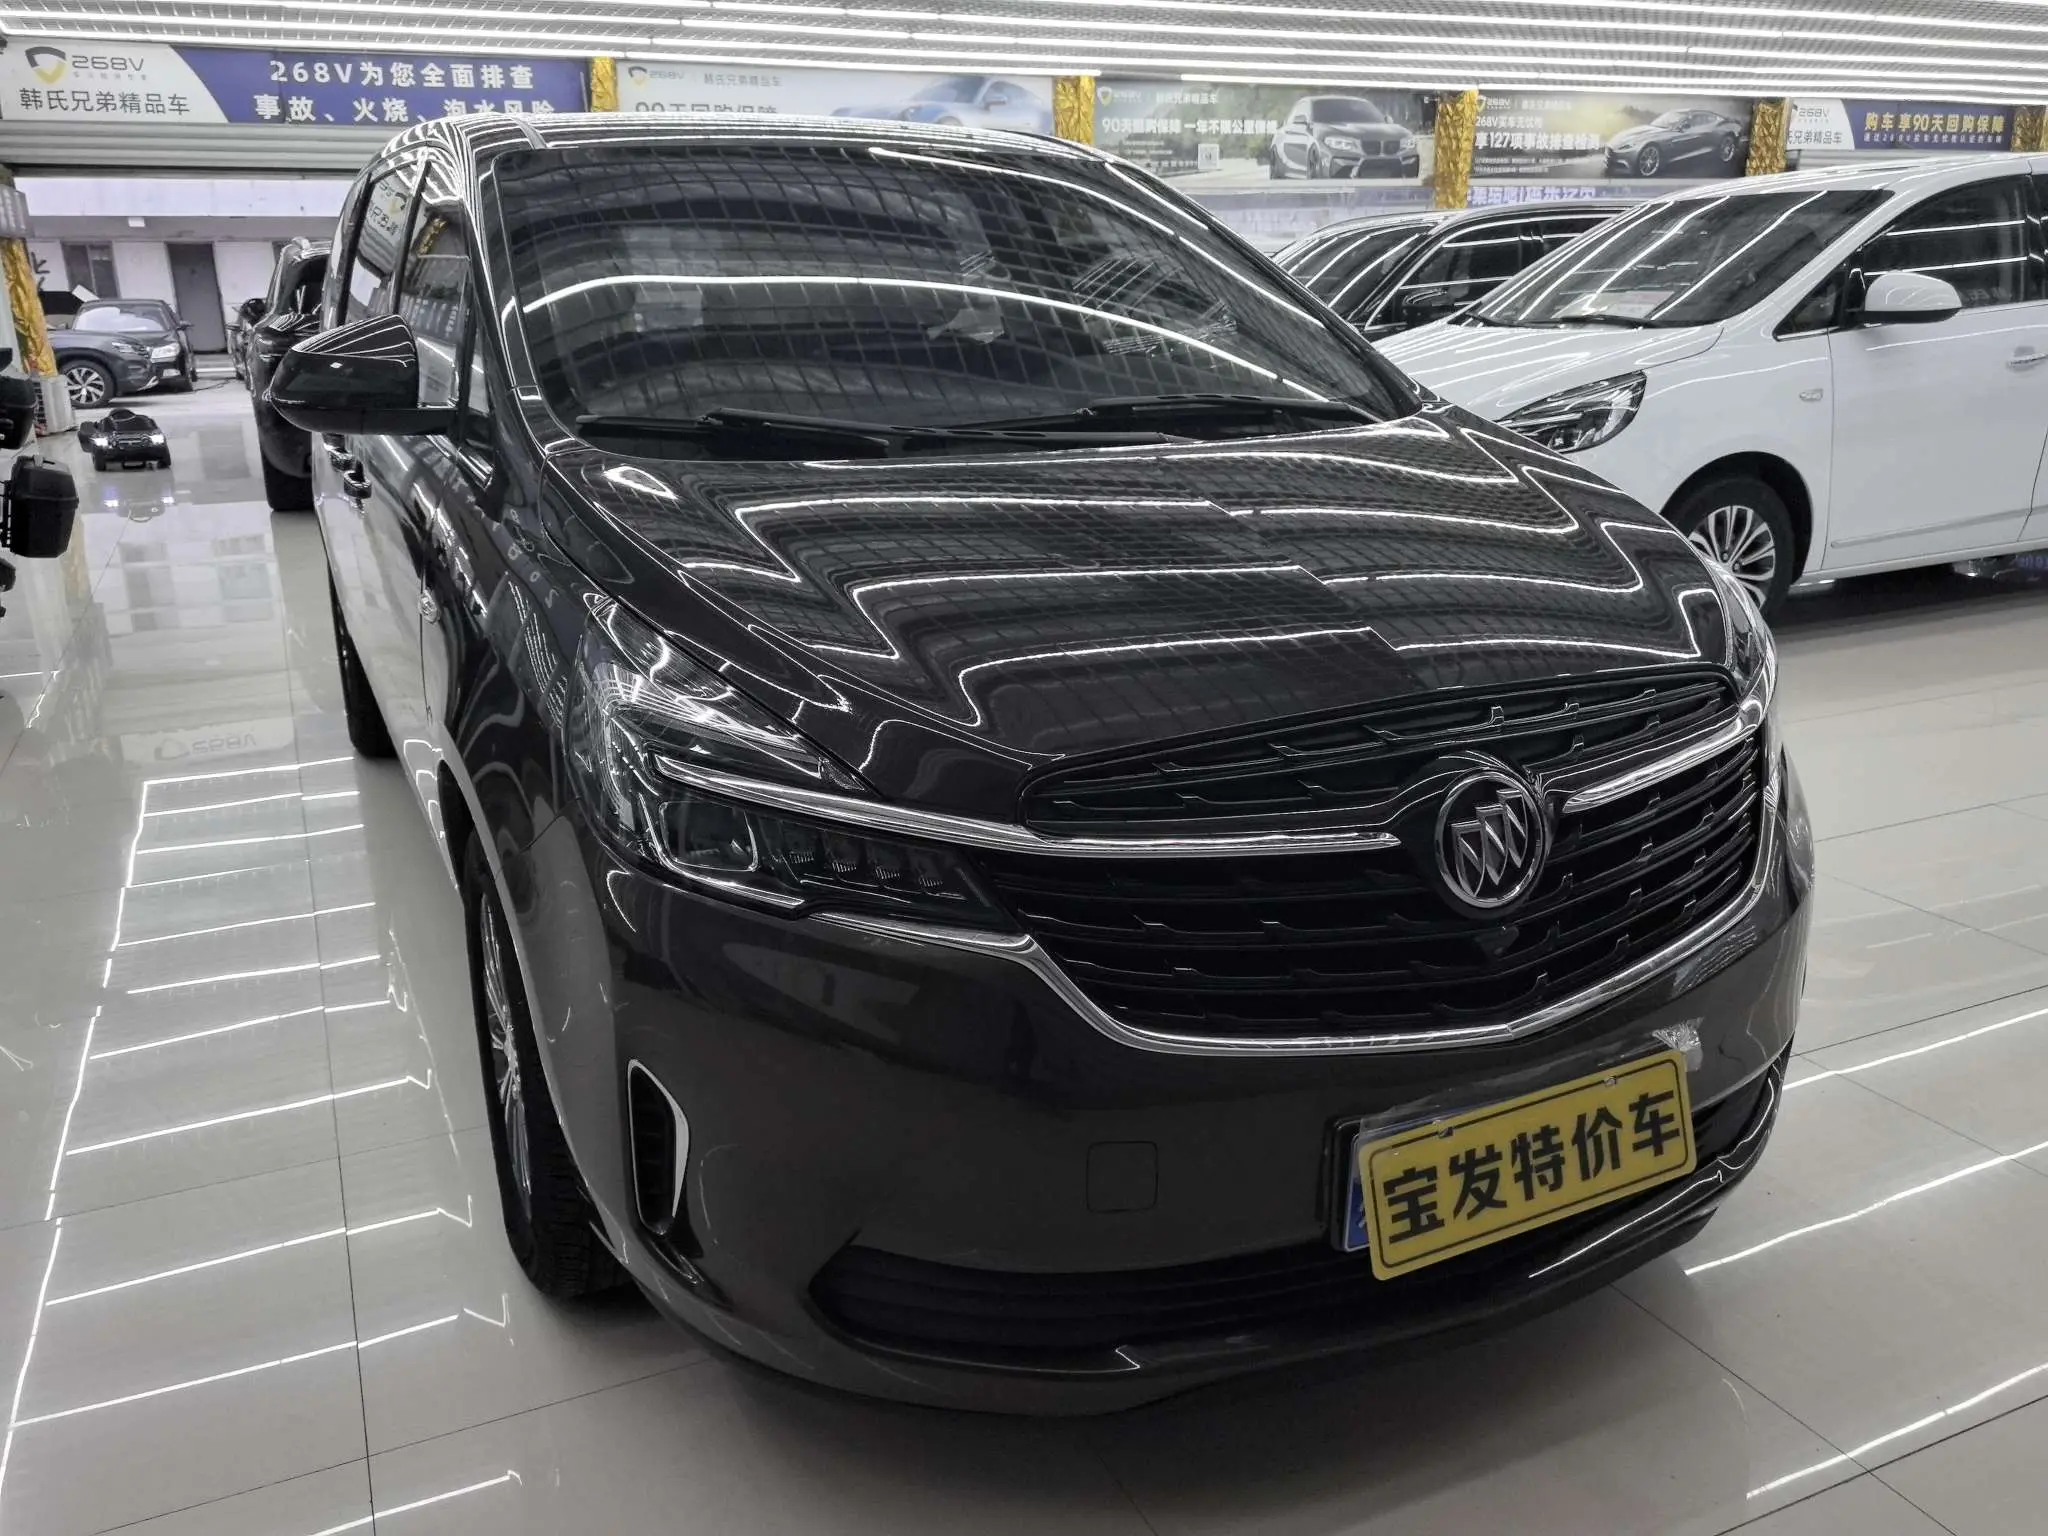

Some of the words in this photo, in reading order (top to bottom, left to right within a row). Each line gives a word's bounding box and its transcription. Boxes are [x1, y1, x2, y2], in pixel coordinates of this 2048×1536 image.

[71, 55, 144, 72] 268V
[269, 60, 535, 89] 268V为您全面排查
[19, 88, 190, 115] 韩氏兄弟精品车
[1383, 1090, 1680, 1244] 宝发特价车
